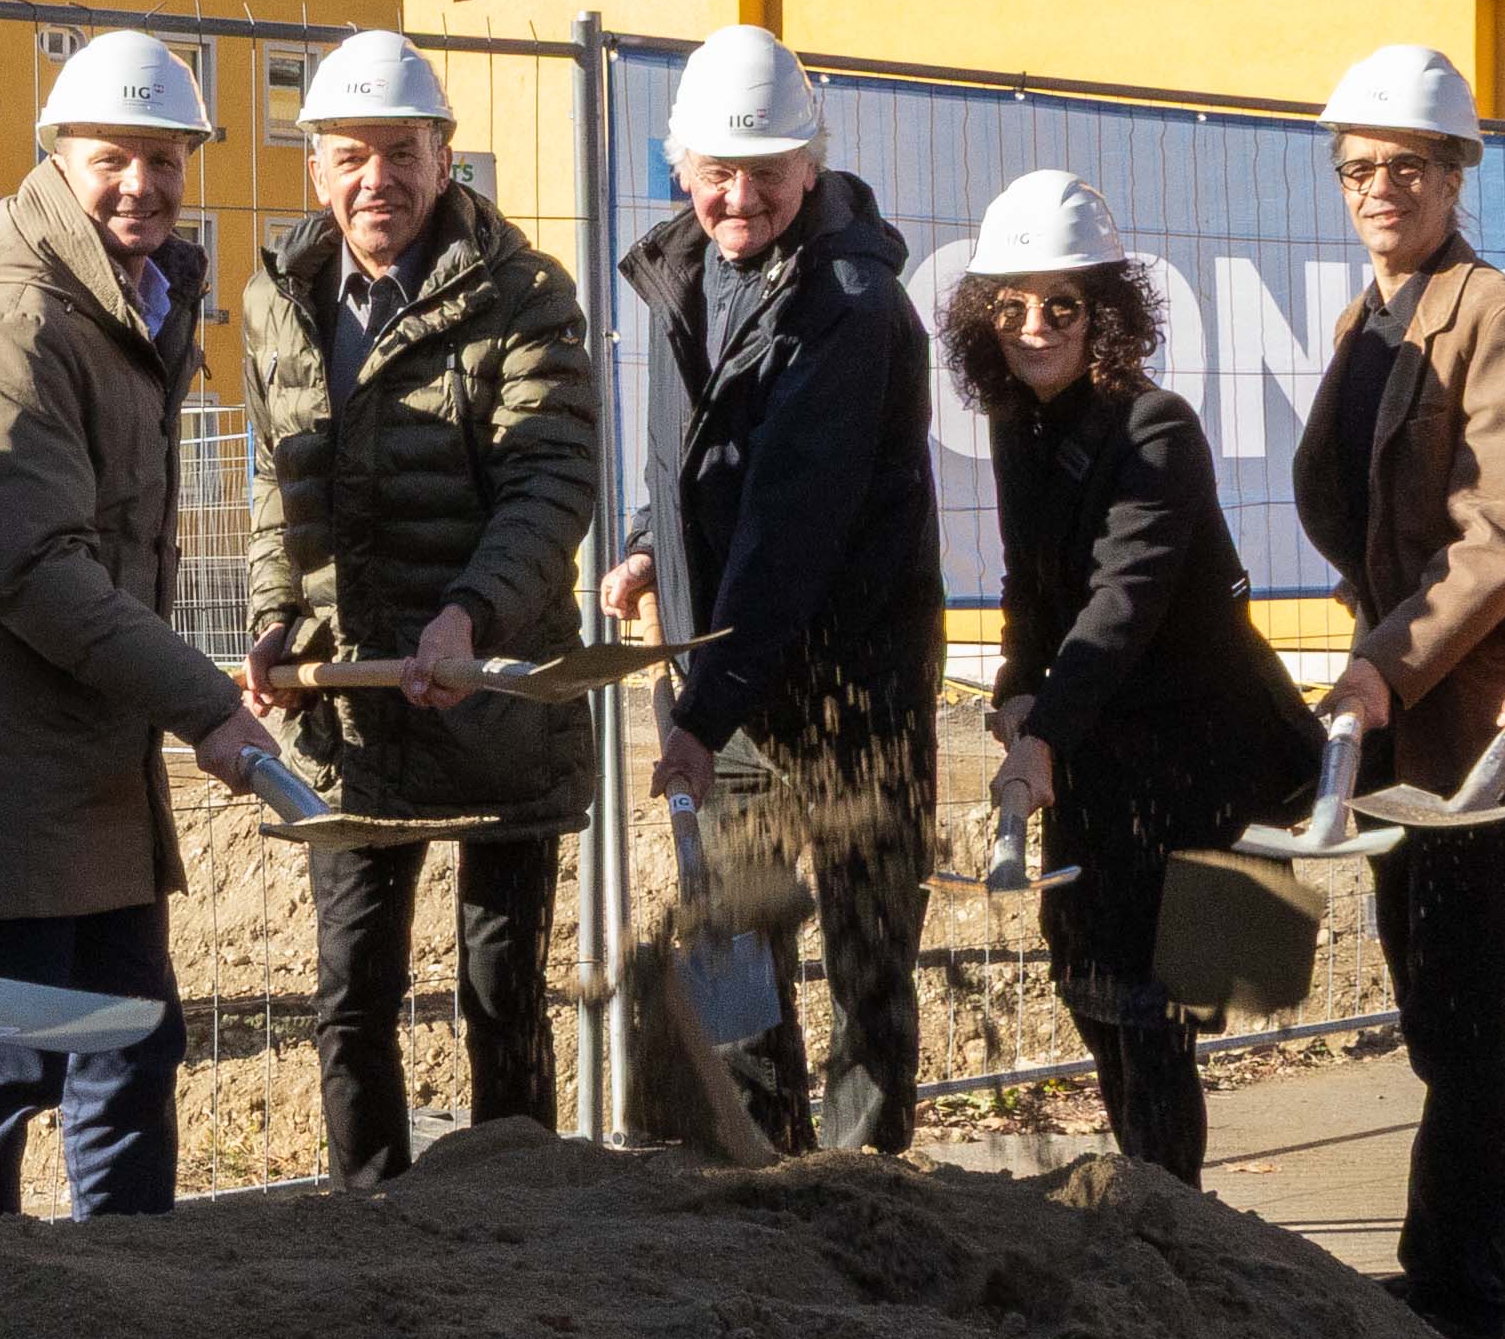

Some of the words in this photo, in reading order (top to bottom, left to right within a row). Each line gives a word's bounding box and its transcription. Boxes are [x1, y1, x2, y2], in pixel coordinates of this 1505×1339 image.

[123, 85, 151, 100] IIG
[347, 82, 371, 94] IIG
[729, 114, 754, 128] IIG
